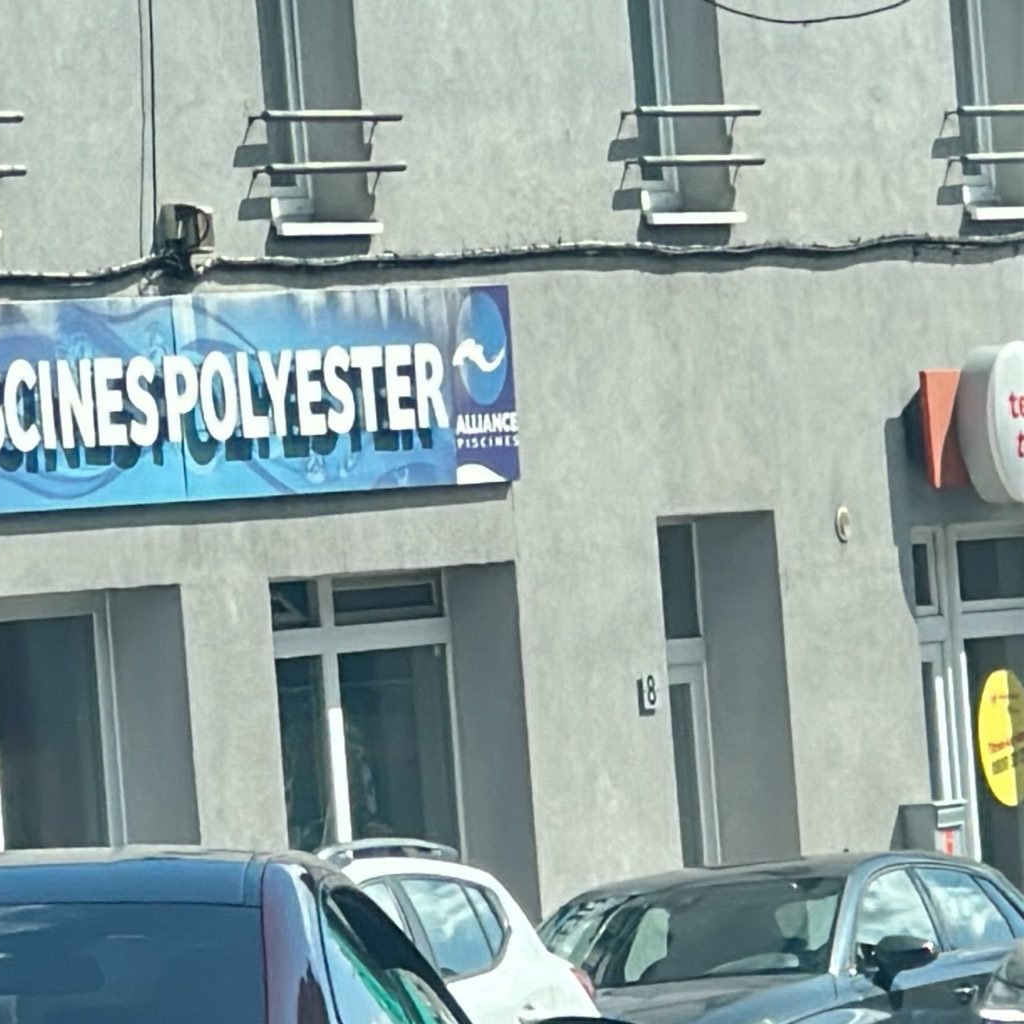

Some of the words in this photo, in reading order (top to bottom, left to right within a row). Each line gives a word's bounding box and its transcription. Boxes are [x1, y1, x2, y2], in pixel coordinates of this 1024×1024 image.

[163, 343, 450, 442] POLYESTER
[456, 411, 518, 435] ALLIANCE
[457, 434, 519, 449] PISCINES
